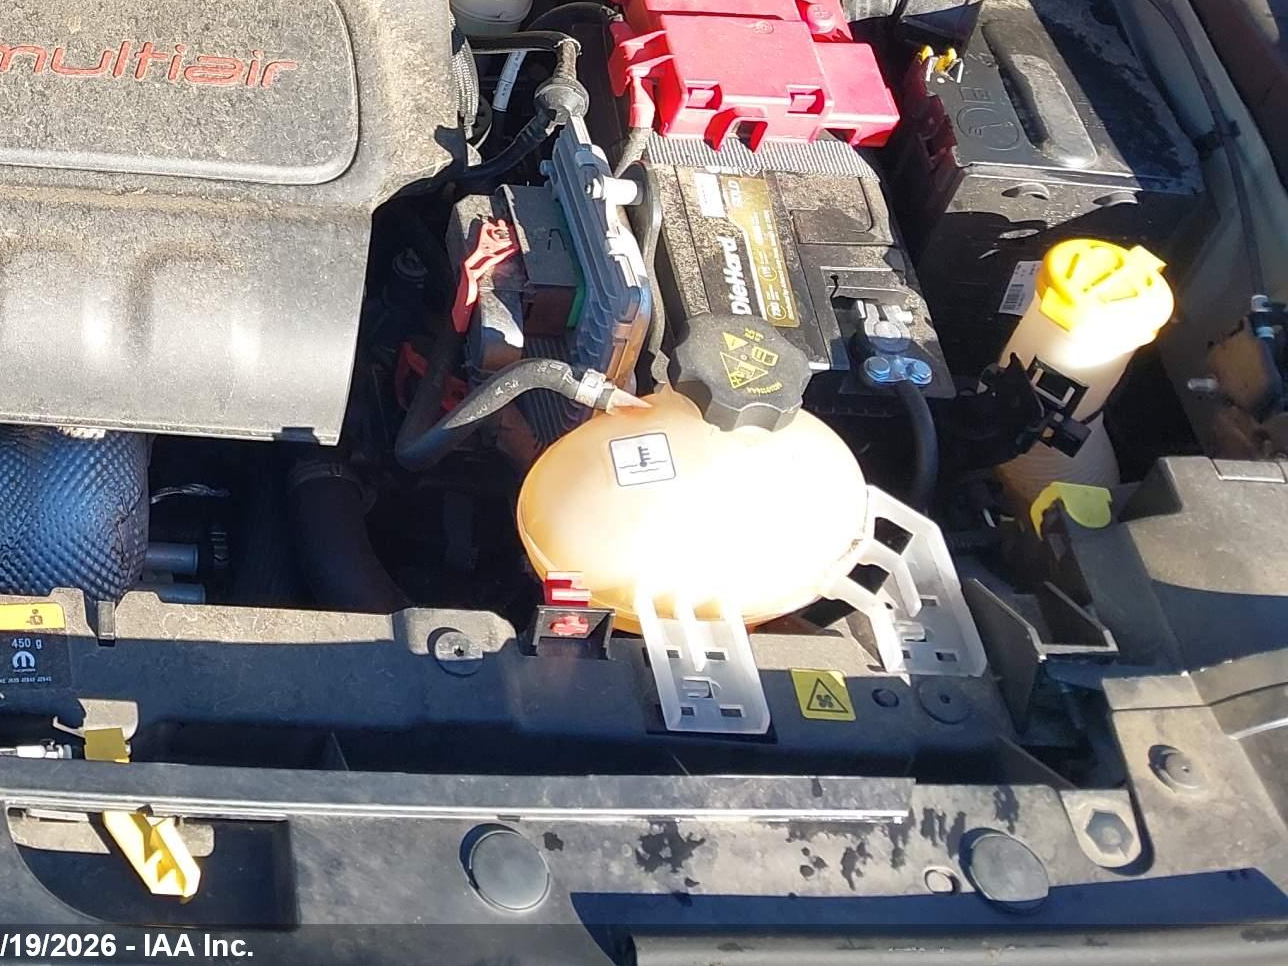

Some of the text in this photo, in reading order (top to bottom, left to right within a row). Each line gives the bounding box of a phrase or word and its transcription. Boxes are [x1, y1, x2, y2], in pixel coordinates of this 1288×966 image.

[718, 235, 753, 316] DieHard
[11, 637, 43, 650] 450 g
